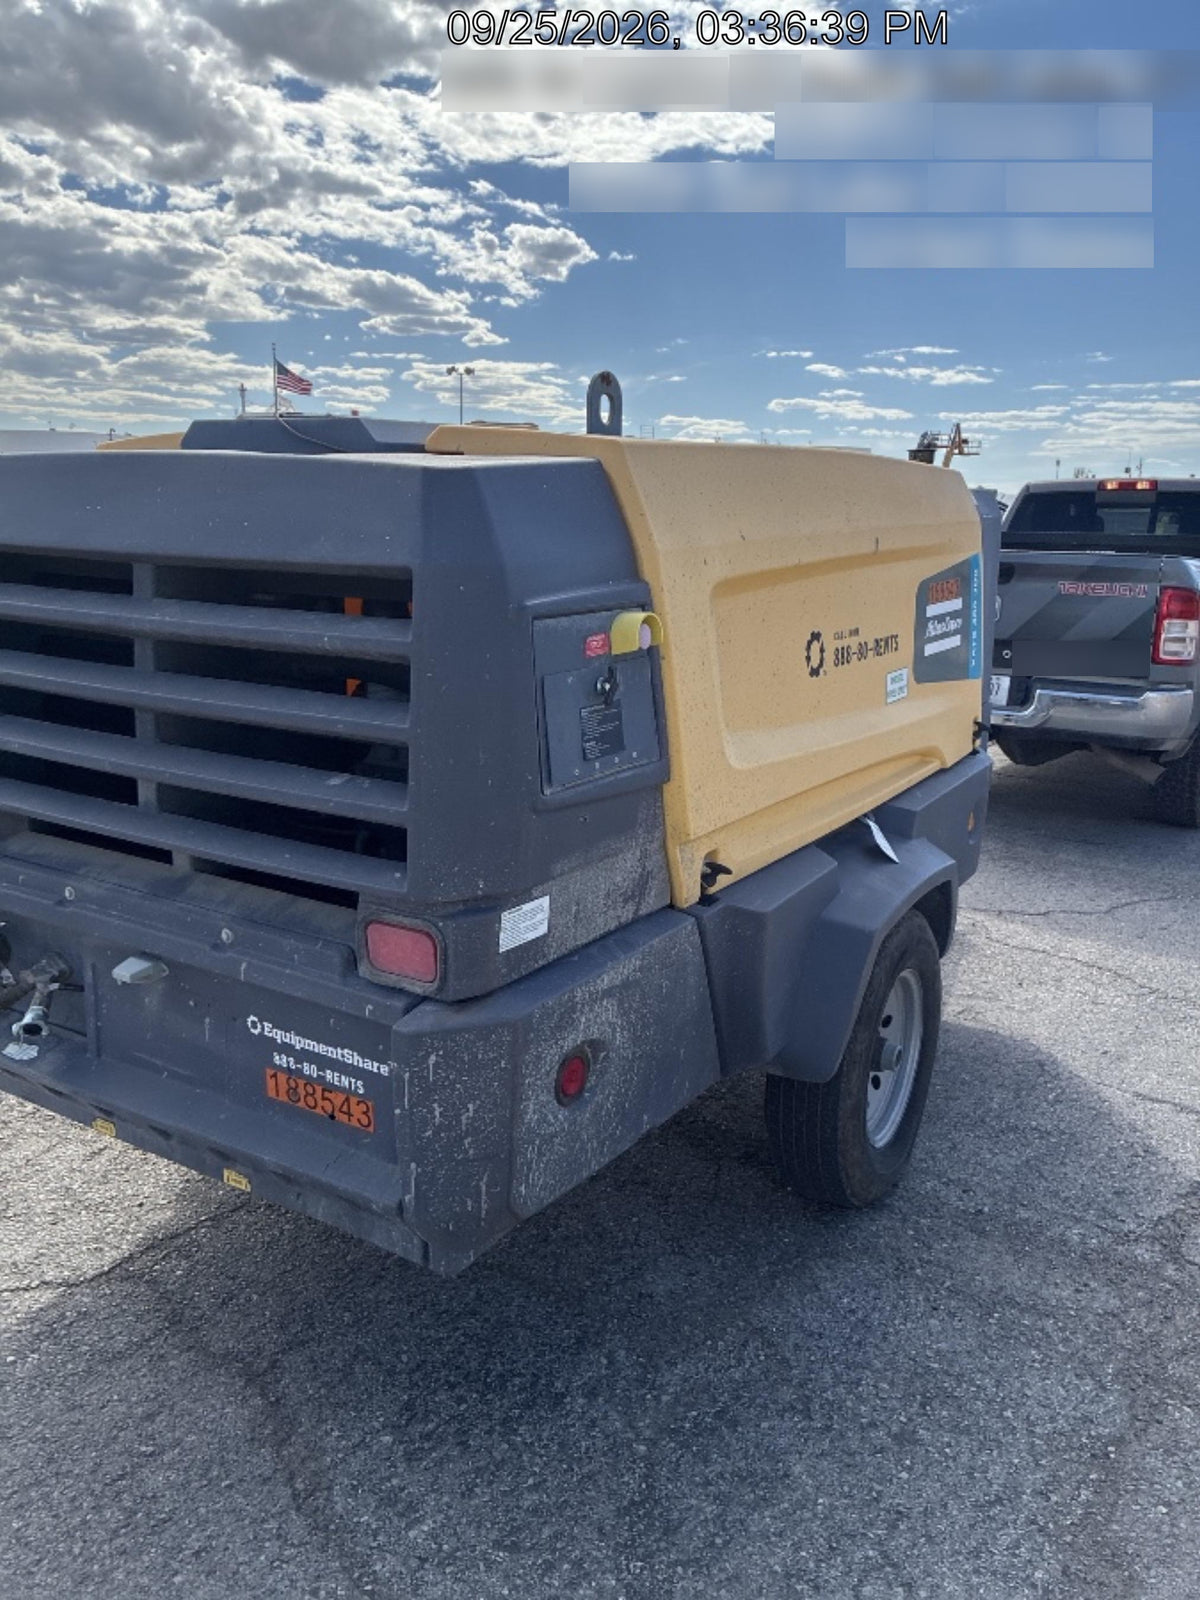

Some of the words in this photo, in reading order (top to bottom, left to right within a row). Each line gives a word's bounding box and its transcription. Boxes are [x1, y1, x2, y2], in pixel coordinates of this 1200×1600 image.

[262, 1021, 390, 1076] EquipmentShare
[272, 1051, 366, 1095] 888-80-RENTS
[269, 1071, 373, 1129] 188543
